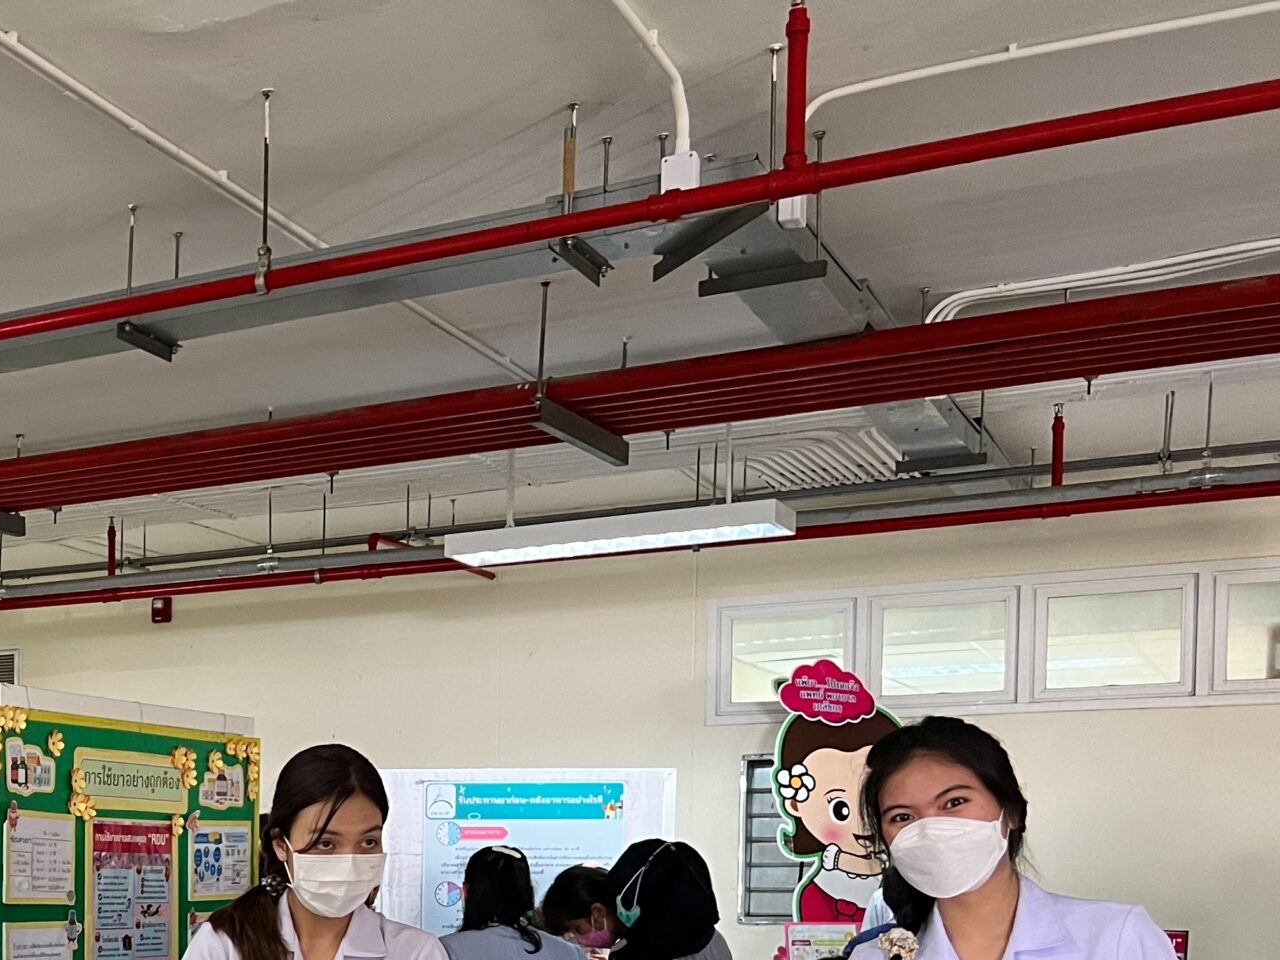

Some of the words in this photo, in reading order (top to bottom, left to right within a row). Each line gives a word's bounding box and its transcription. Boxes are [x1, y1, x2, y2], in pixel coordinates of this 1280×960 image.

[84, 765, 180, 793] การใช้ยาอย่างถูกต้อง
